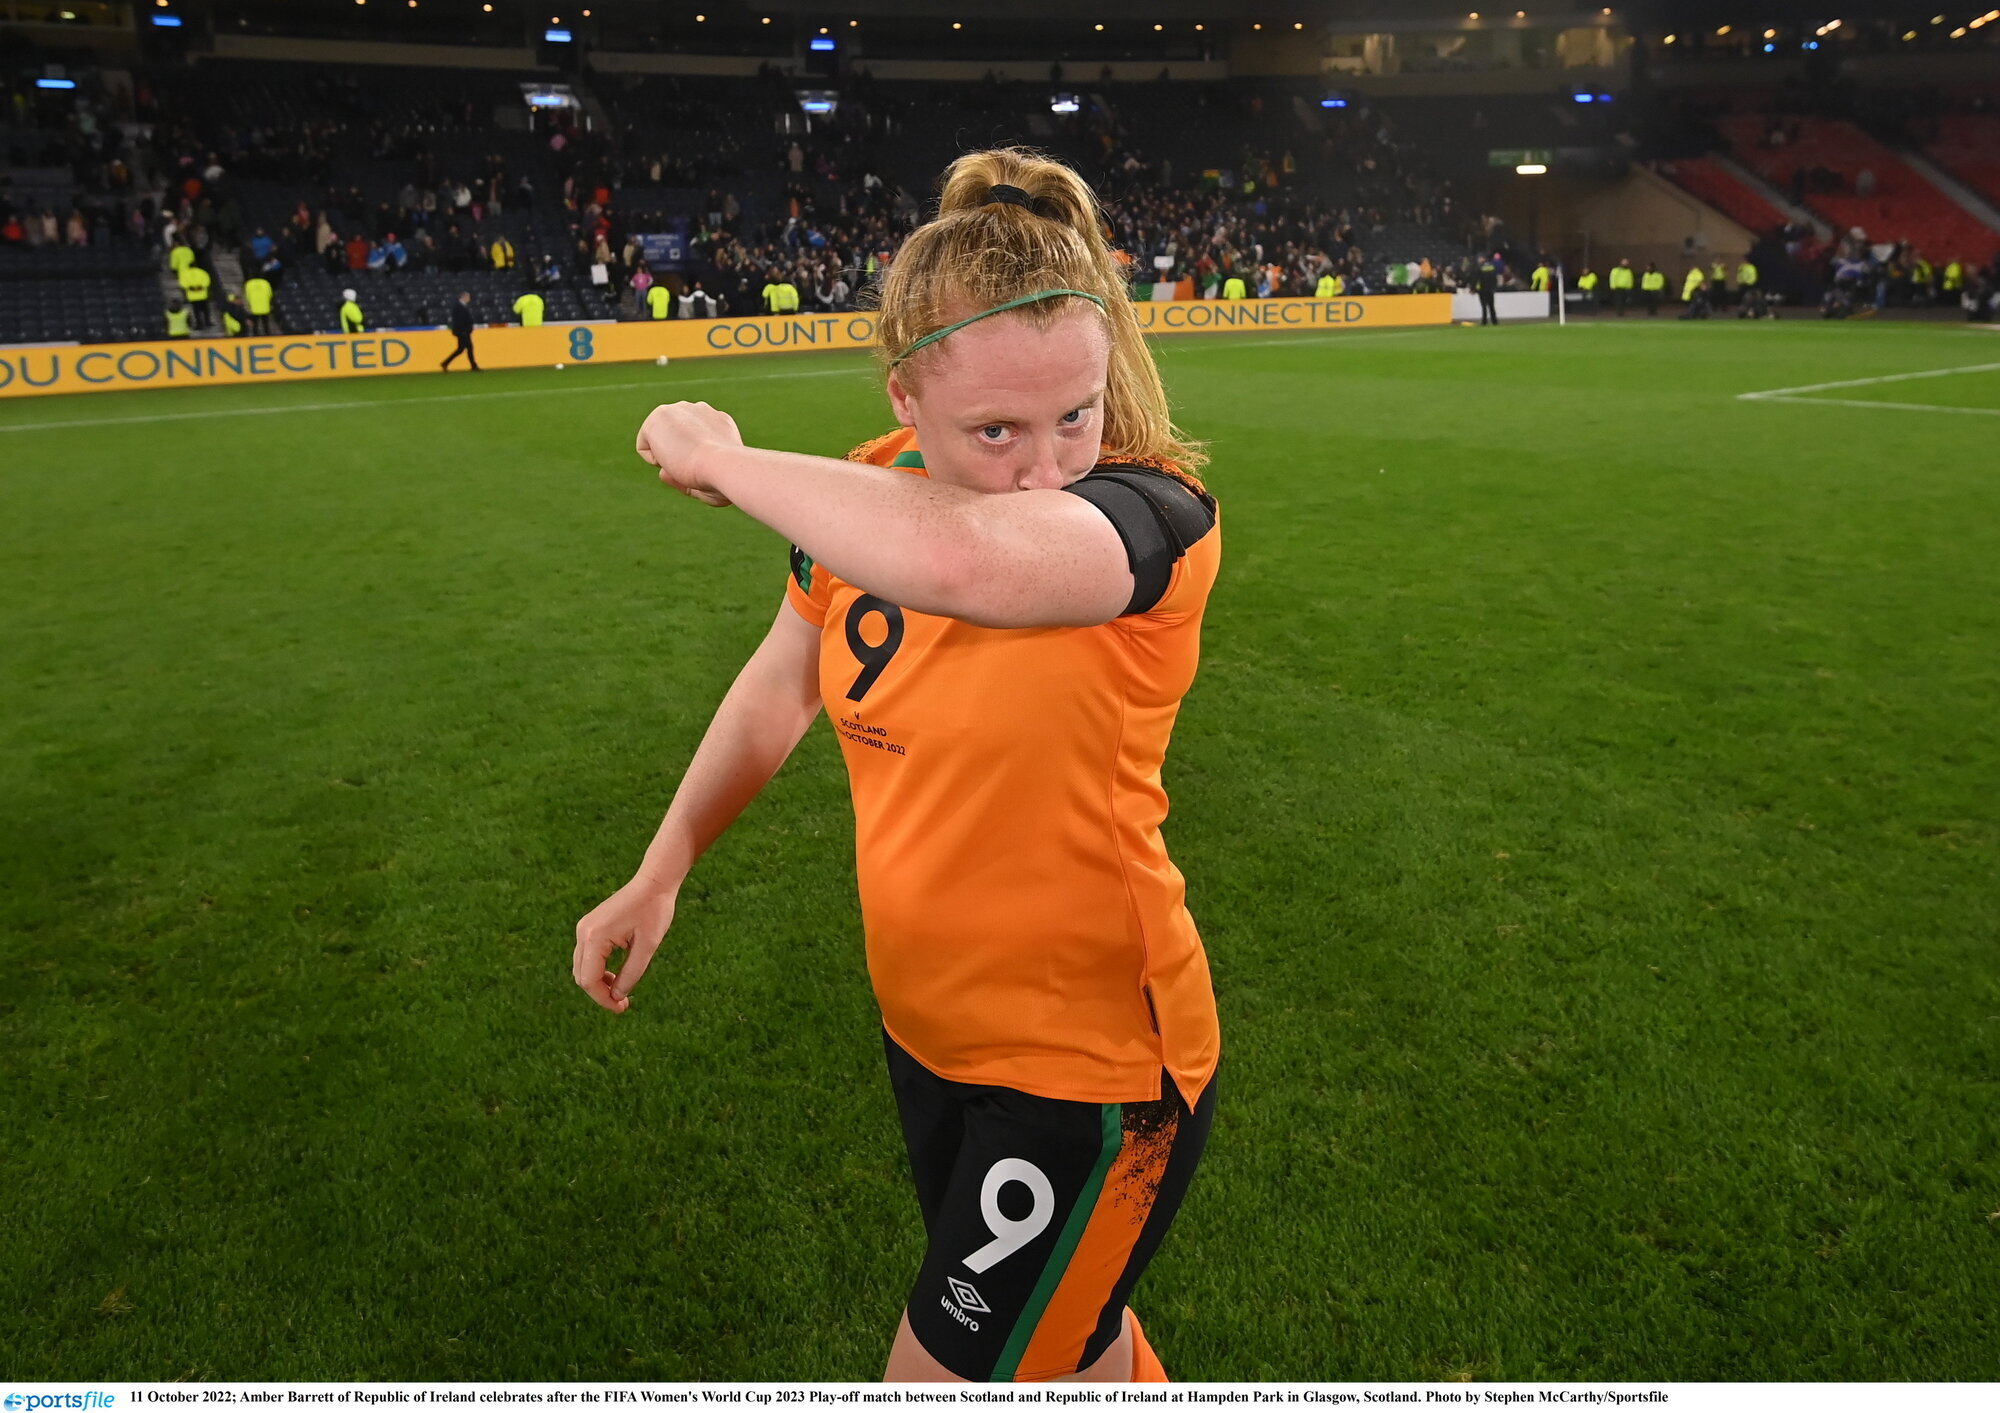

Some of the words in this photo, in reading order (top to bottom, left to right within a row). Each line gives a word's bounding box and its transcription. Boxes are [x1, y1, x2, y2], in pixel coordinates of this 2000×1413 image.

[1163, 301, 1364, 327] CONNECTED
[707, 319, 839, 349] COUNT
[75, 339, 411, 382] CONNECTED
[845, 593, 905, 702] 9
[840, 717, 887, 737] SCOTLAND
[845, 731, 885, 750] OCTOBER
[885, 742, 906, 756] 2022
[961, 1157, 1055, 1275] 9
[940, 1295, 980, 1333] umbro
